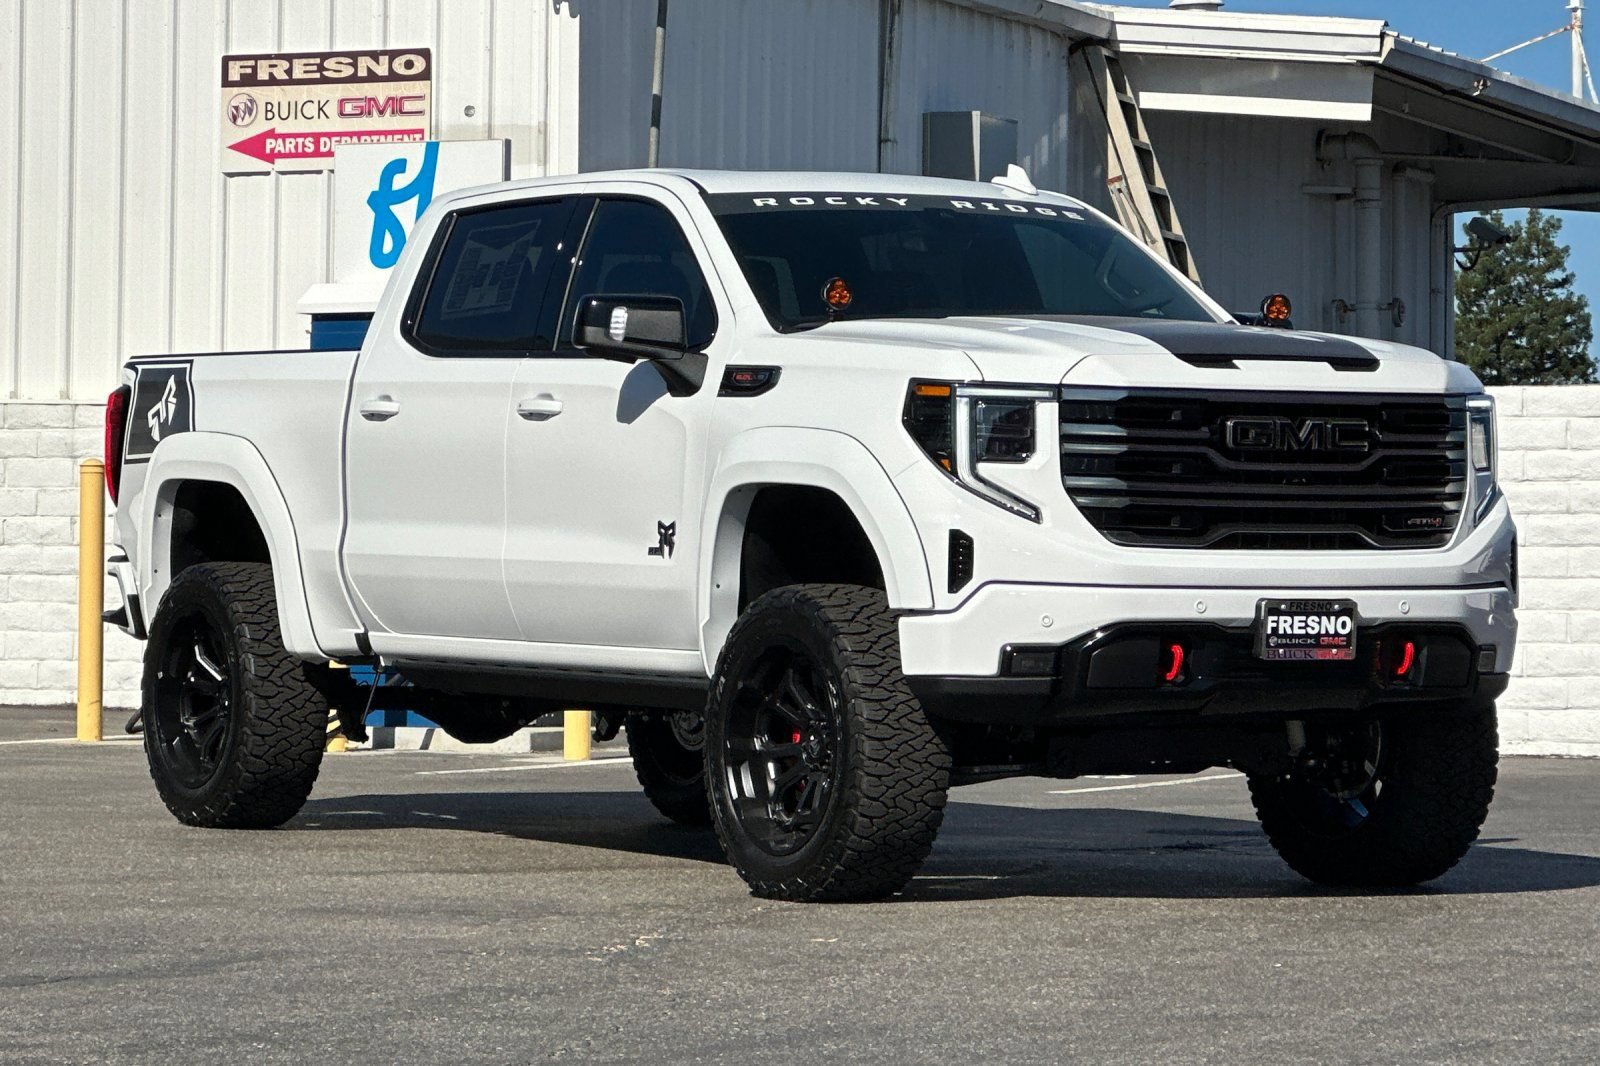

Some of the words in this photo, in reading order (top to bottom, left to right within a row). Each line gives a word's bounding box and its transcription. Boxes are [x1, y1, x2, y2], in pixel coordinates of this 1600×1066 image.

[228, 54, 426, 81] FRESNO
[264, 99, 330, 121] BUICK
[337, 93, 426, 119] GMC
[265, 137, 315, 154] PARTS
[752, 196, 908, 207] ROCKY
[950, 200, 1085, 220] RIDGE
[1225, 416, 1369, 452] GMC
[1289, 602, 1332, 611] FRESNO
[1267, 615, 1352, 634] FRESNO
[1278, 637, 1316, 645] BUICK
[1320, 637, 1347, 645] GMC
[1267, 649, 1313, 659] BUICK
